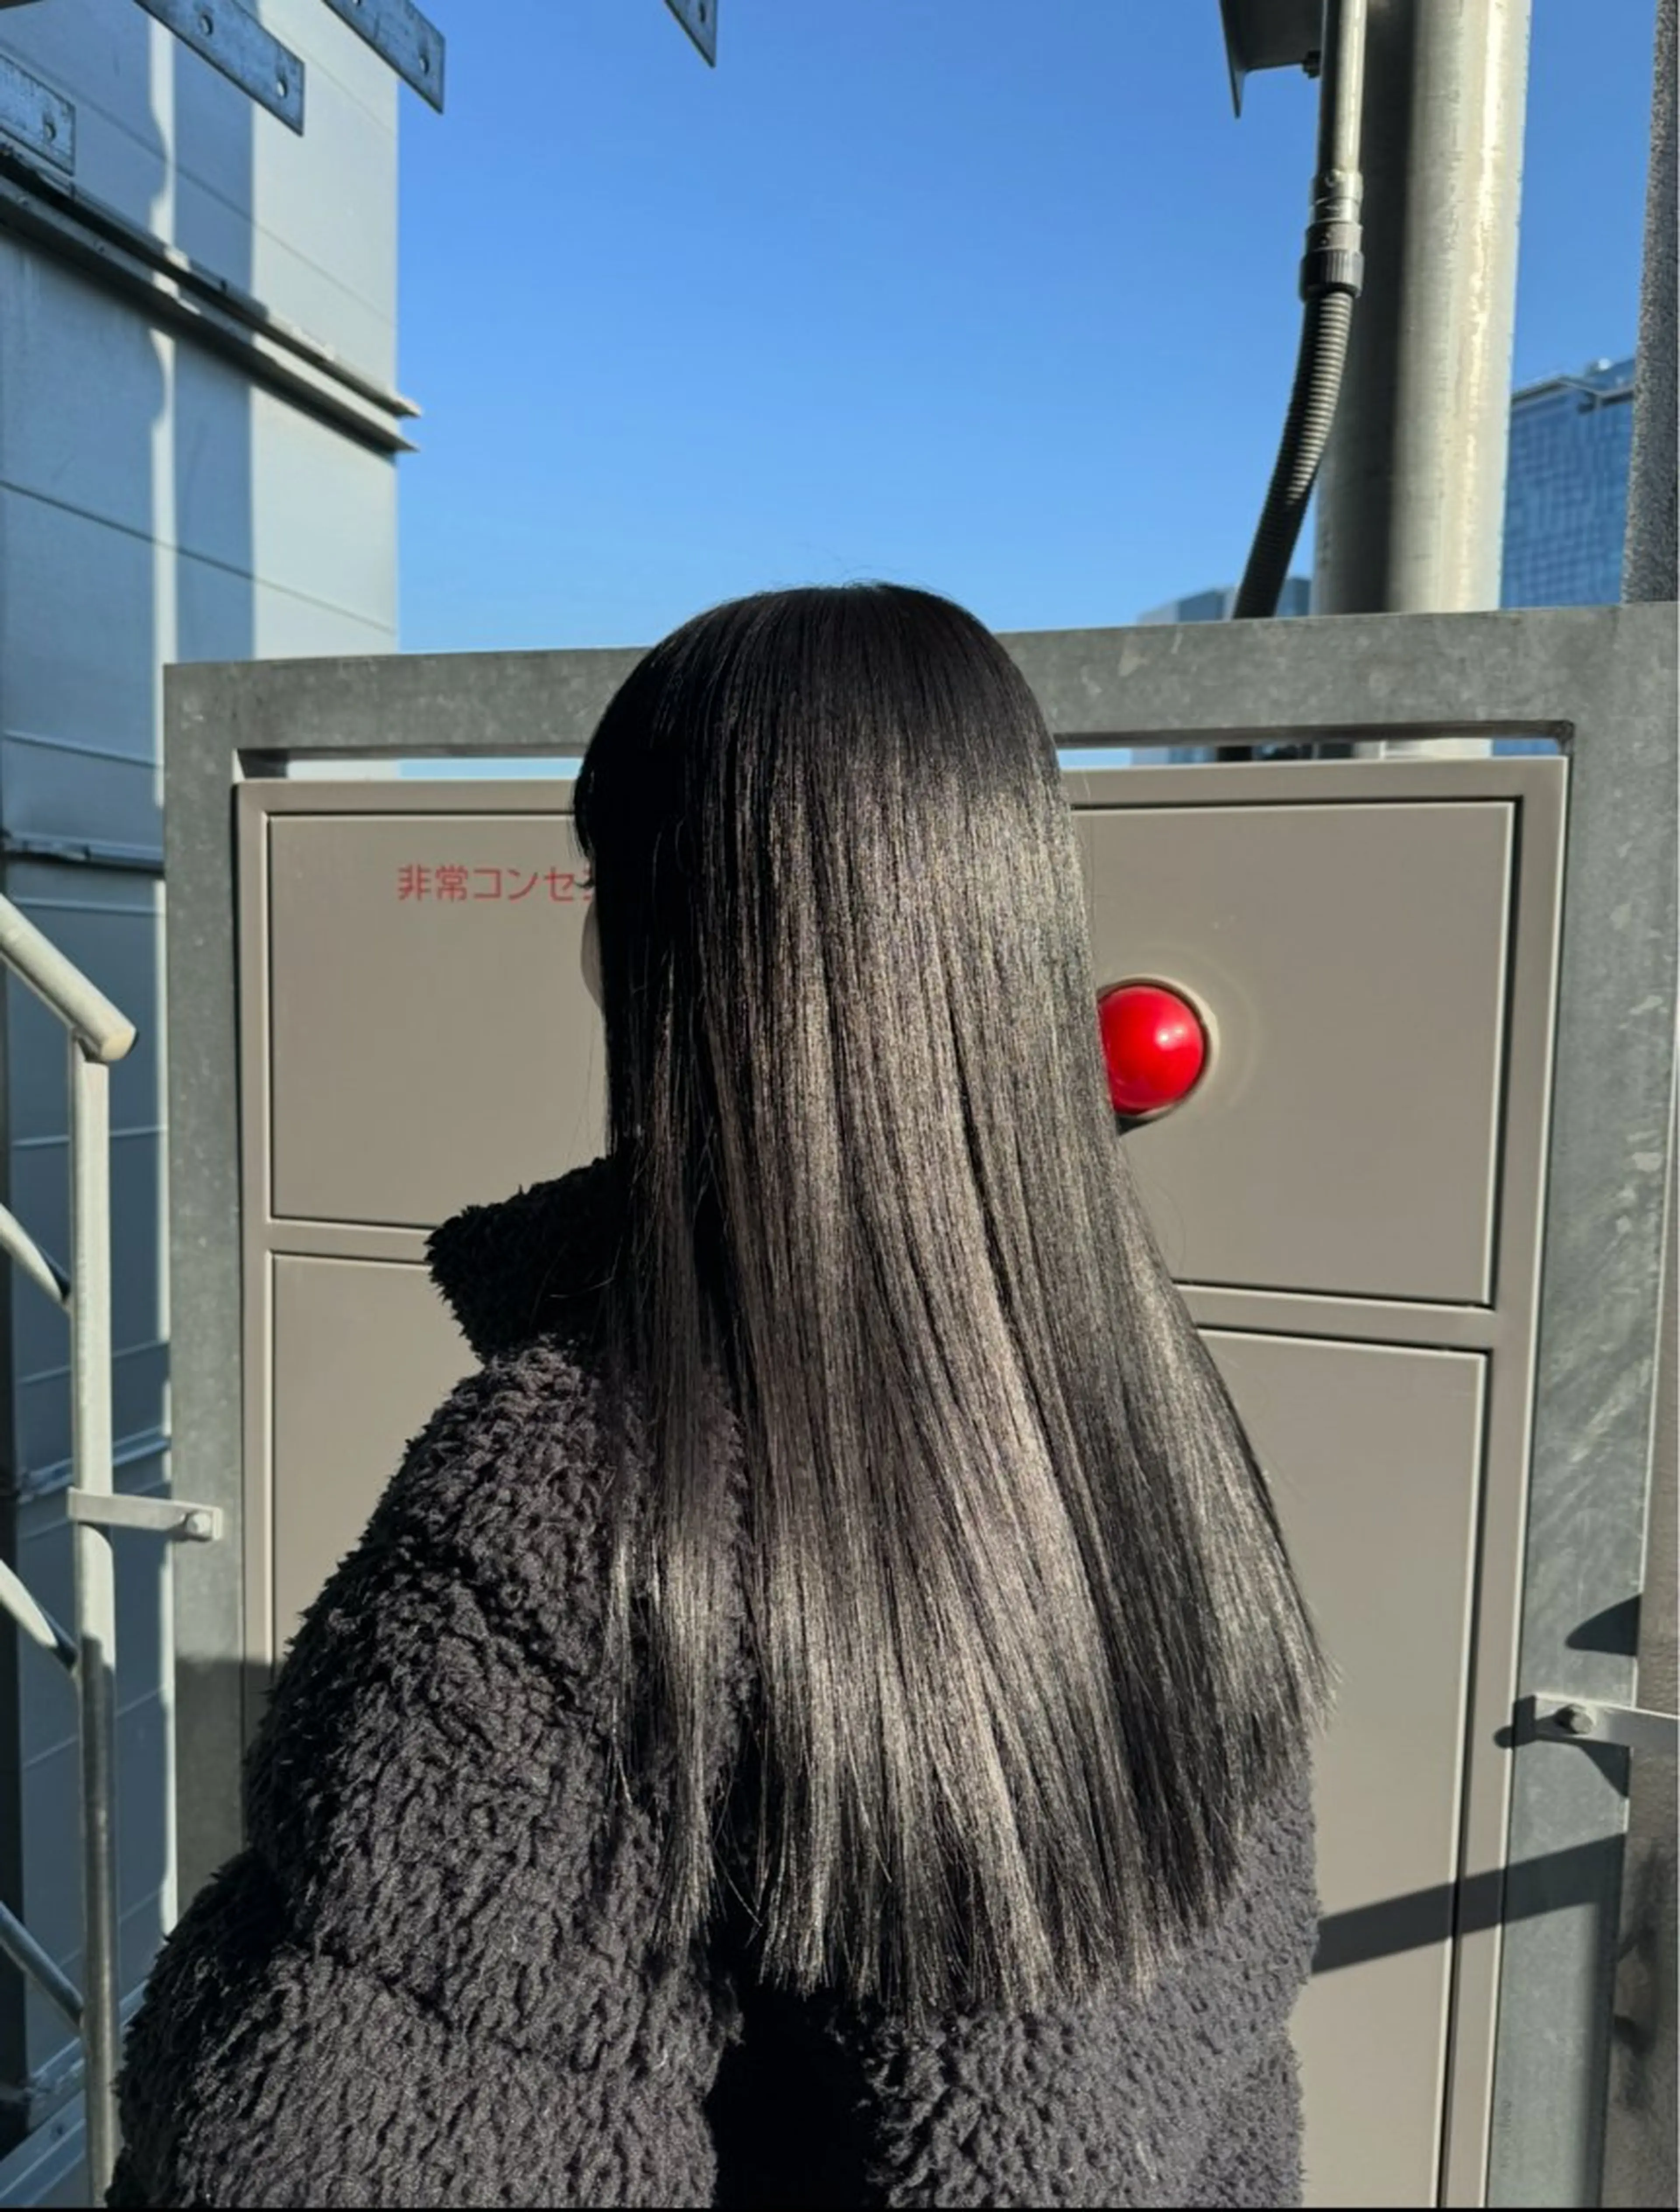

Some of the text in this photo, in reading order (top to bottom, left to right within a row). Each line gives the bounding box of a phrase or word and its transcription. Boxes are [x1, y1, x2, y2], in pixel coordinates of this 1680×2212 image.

[398, 864, 592, 903] 非常コンセ
